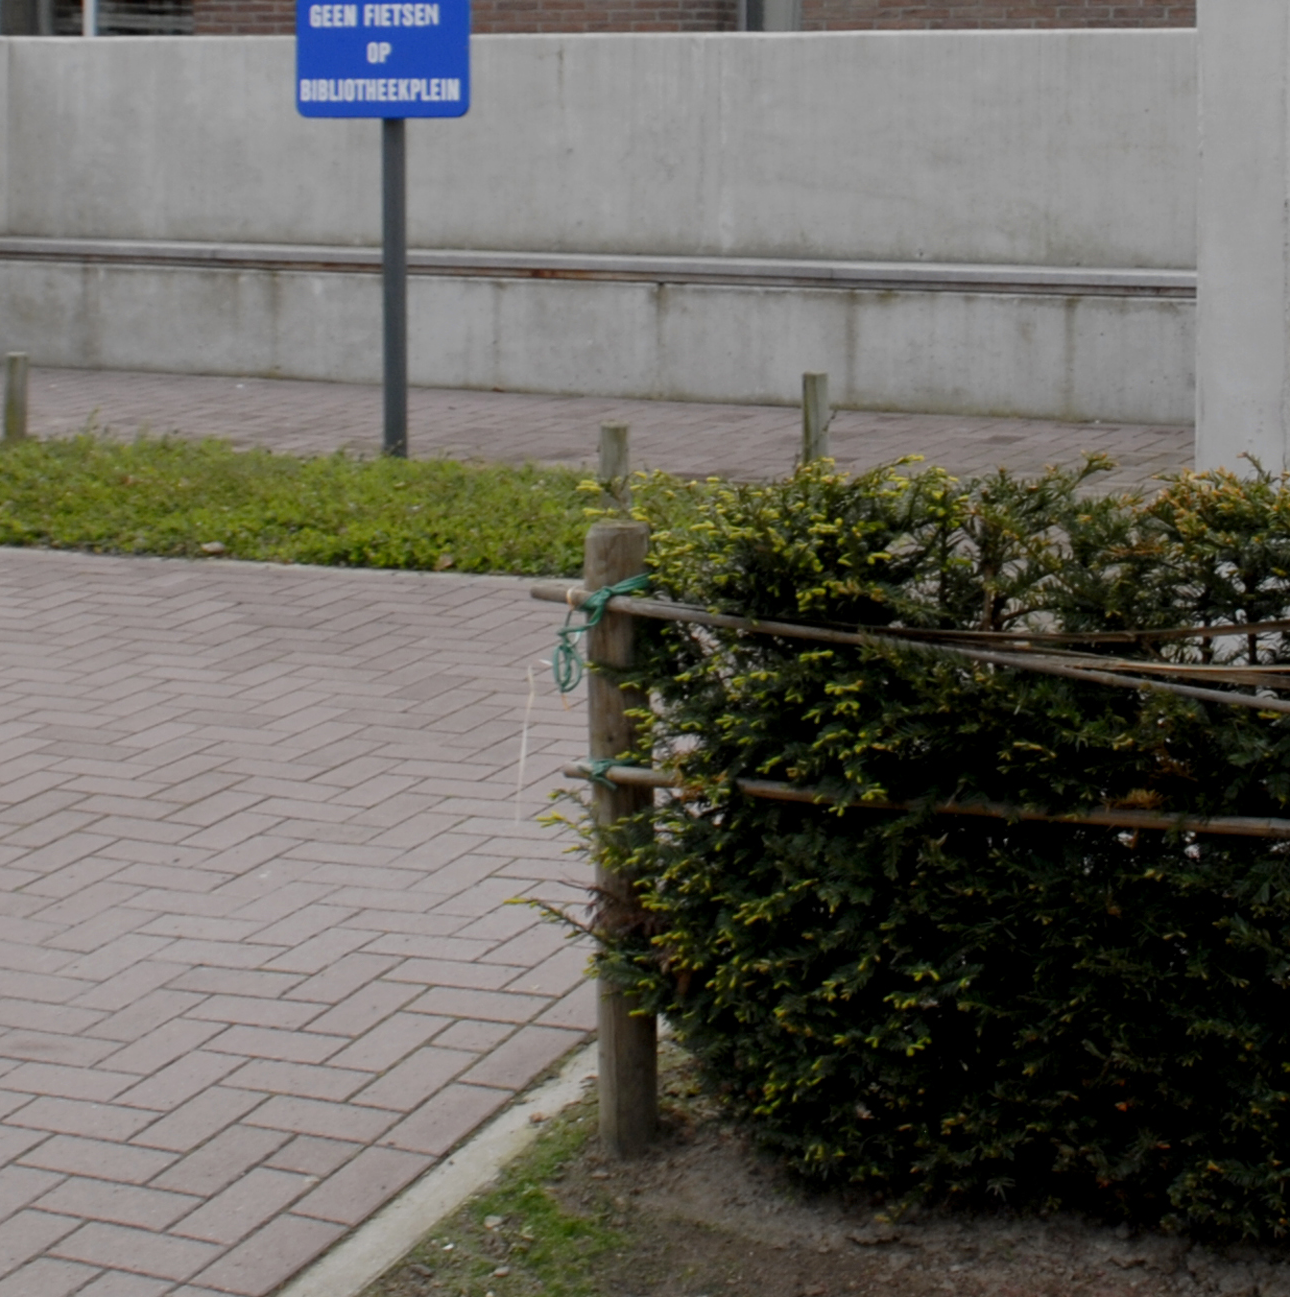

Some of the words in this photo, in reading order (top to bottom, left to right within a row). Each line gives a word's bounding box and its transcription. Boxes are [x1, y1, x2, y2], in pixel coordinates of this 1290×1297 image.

[309, 4, 357, 28] GEEN
[363, 3, 440, 27] FIETSEN
[366, 42, 391, 64] OP
[300, 78, 460, 102] BIBLIOTHEEKPLEIN
